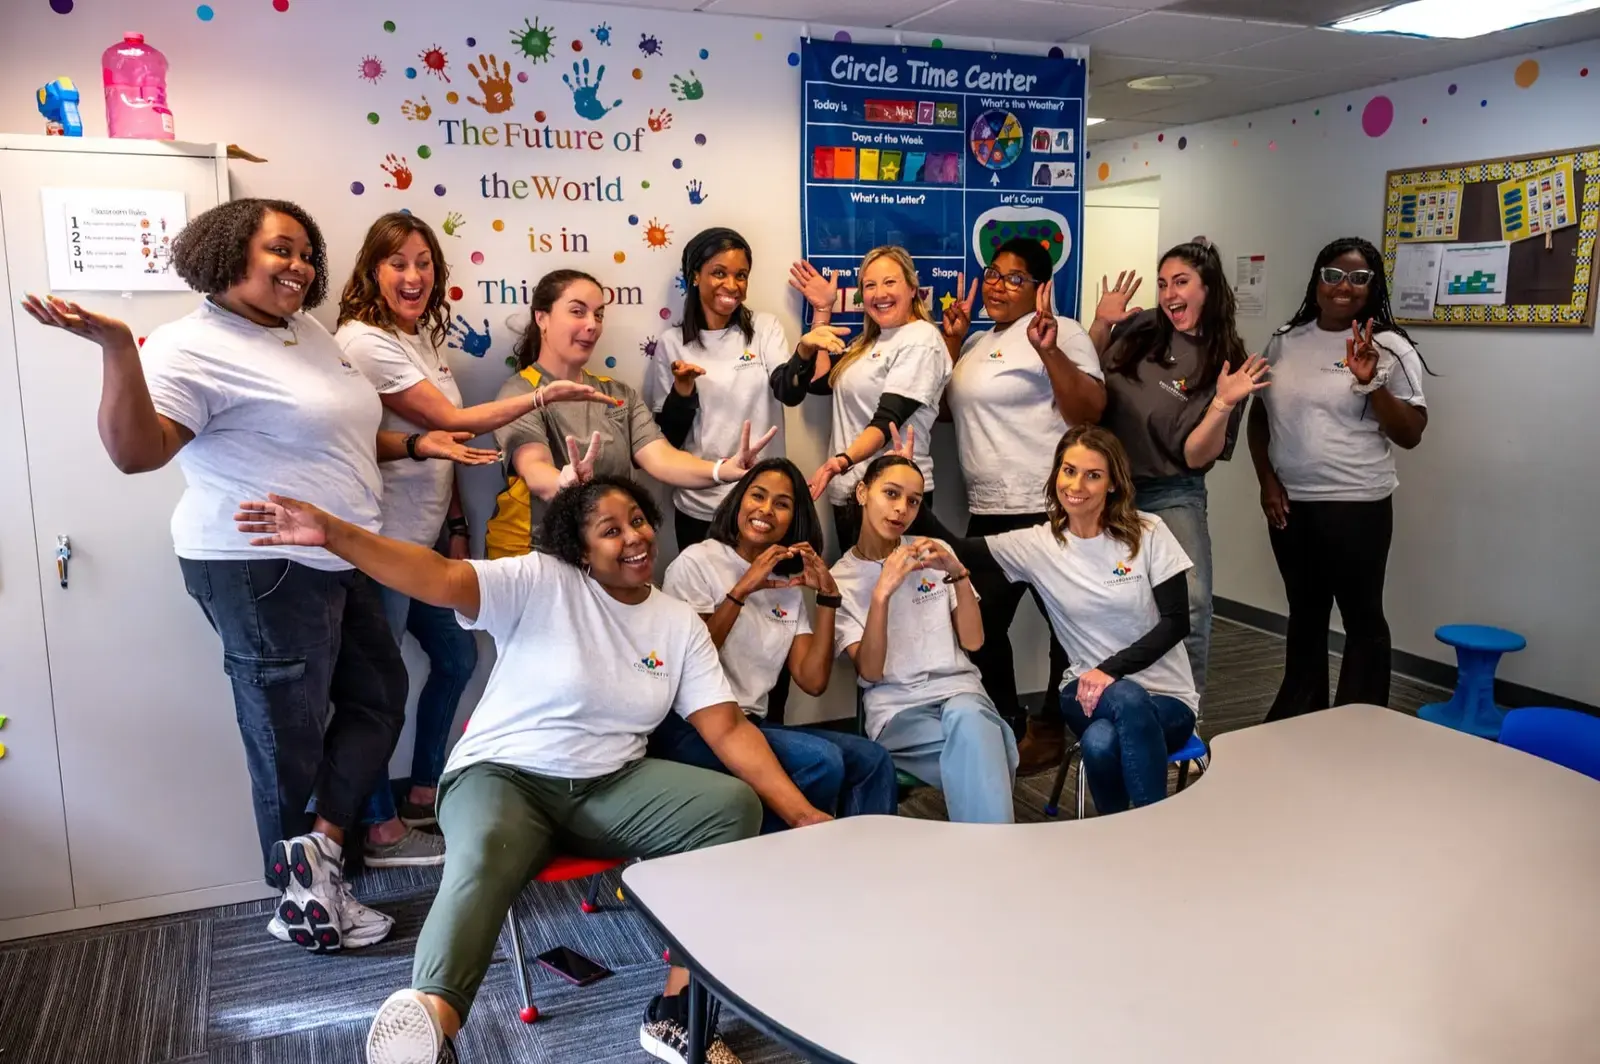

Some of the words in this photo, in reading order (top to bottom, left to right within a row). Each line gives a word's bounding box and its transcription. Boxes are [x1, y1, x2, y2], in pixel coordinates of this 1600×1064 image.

[830, 54, 899, 83] Circle
[906, 59, 959, 88] Time
[964, 64, 1038, 92] Center
[813, 99, 840, 112] Today
[841, 101, 848, 111] is
[980, 98, 1010, 109] What's
[1012, 100, 1026, 109] the
[1028, 100, 1065, 111] Weather?
[895, 106, 915, 118] May
[923, 109, 930, 118] 7
[438, 118, 499, 146] The
[503, 122, 605, 150] Future
[613, 127, 646, 152] of
[852, 131, 872, 145] Days
[874, 133, 883, 143] of
[884, 134, 899, 144] the
[900, 135, 924, 145] Week
[480, 172, 529, 199] the
[530, 174, 625, 202] World
[850, 192, 879, 203] What's
[880, 194, 894, 204] the
[896, 194, 926, 205] Letter?
[1000, 193, 1019, 204] Let's
[1020, 194, 1044, 204] Count
[70, 216, 79, 229] 1
[71, 231, 81, 243] 2
[528, 227, 553, 253] is
[560, 227, 589, 253] in
[73, 245, 82, 257] 3
[73, 259, 84, 273] 4
[931, 267, 958, 279] Shape
